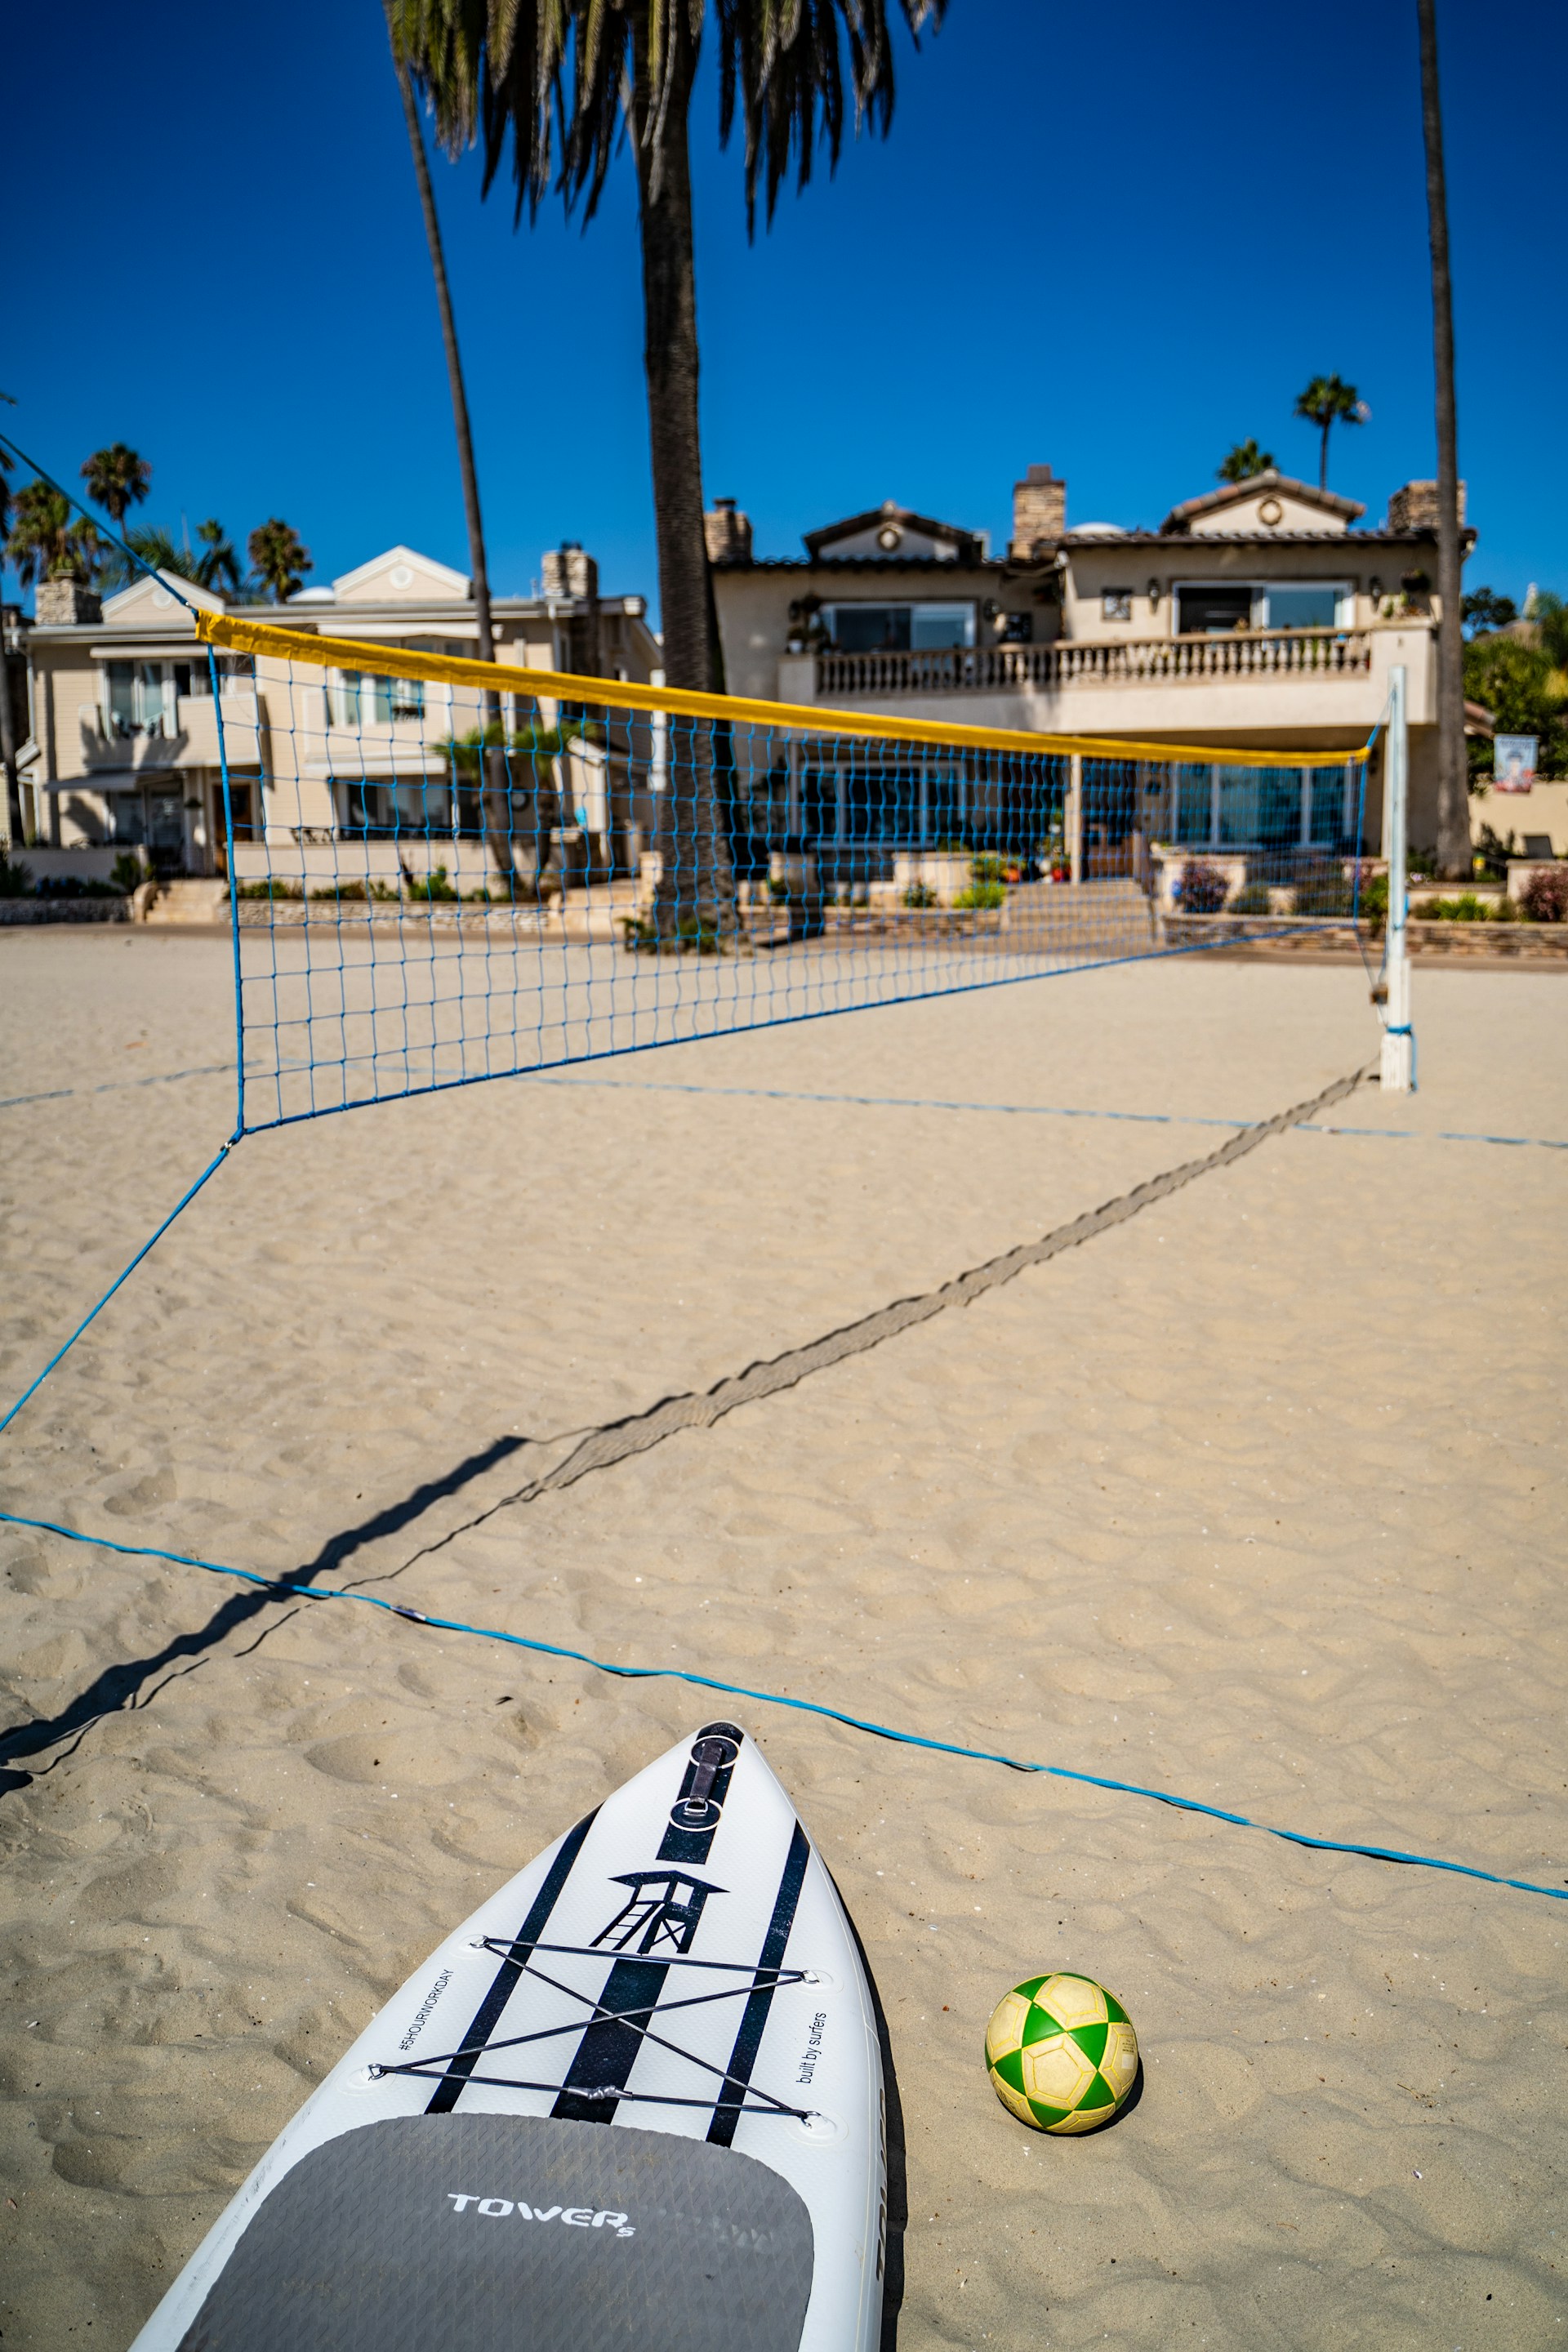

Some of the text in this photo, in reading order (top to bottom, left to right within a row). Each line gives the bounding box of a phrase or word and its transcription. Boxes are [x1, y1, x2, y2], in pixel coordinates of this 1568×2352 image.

[398, 1969, 454, 2051] #5HOURWORKDAY
[795, 2012, 826, 2084] built by surfers
